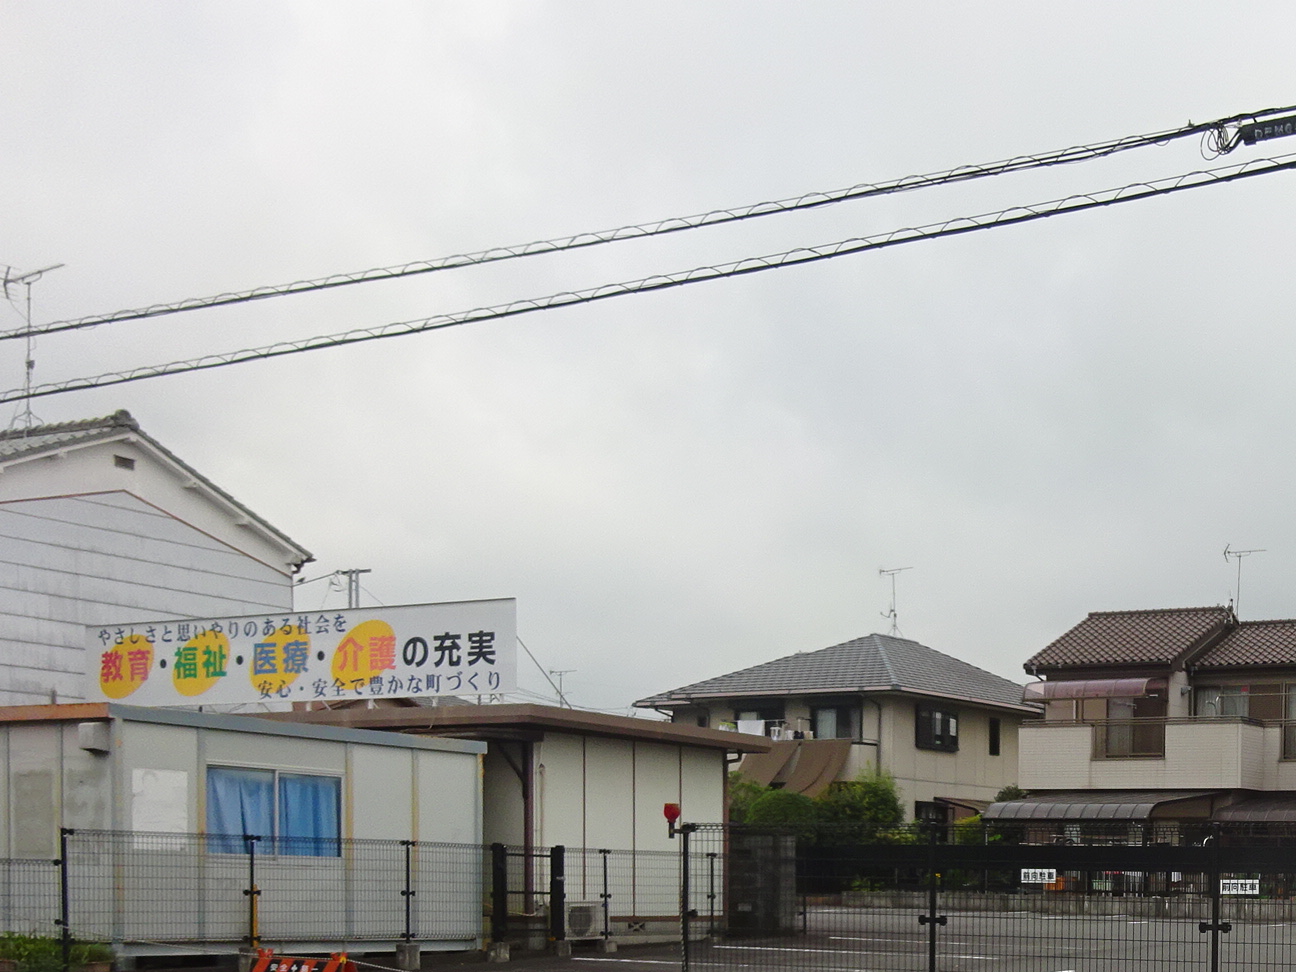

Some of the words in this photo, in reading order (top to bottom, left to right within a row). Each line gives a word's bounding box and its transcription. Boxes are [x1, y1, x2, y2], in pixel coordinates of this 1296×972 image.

[98, 614, 347, 645] やさしさと思いやりのある社会を
